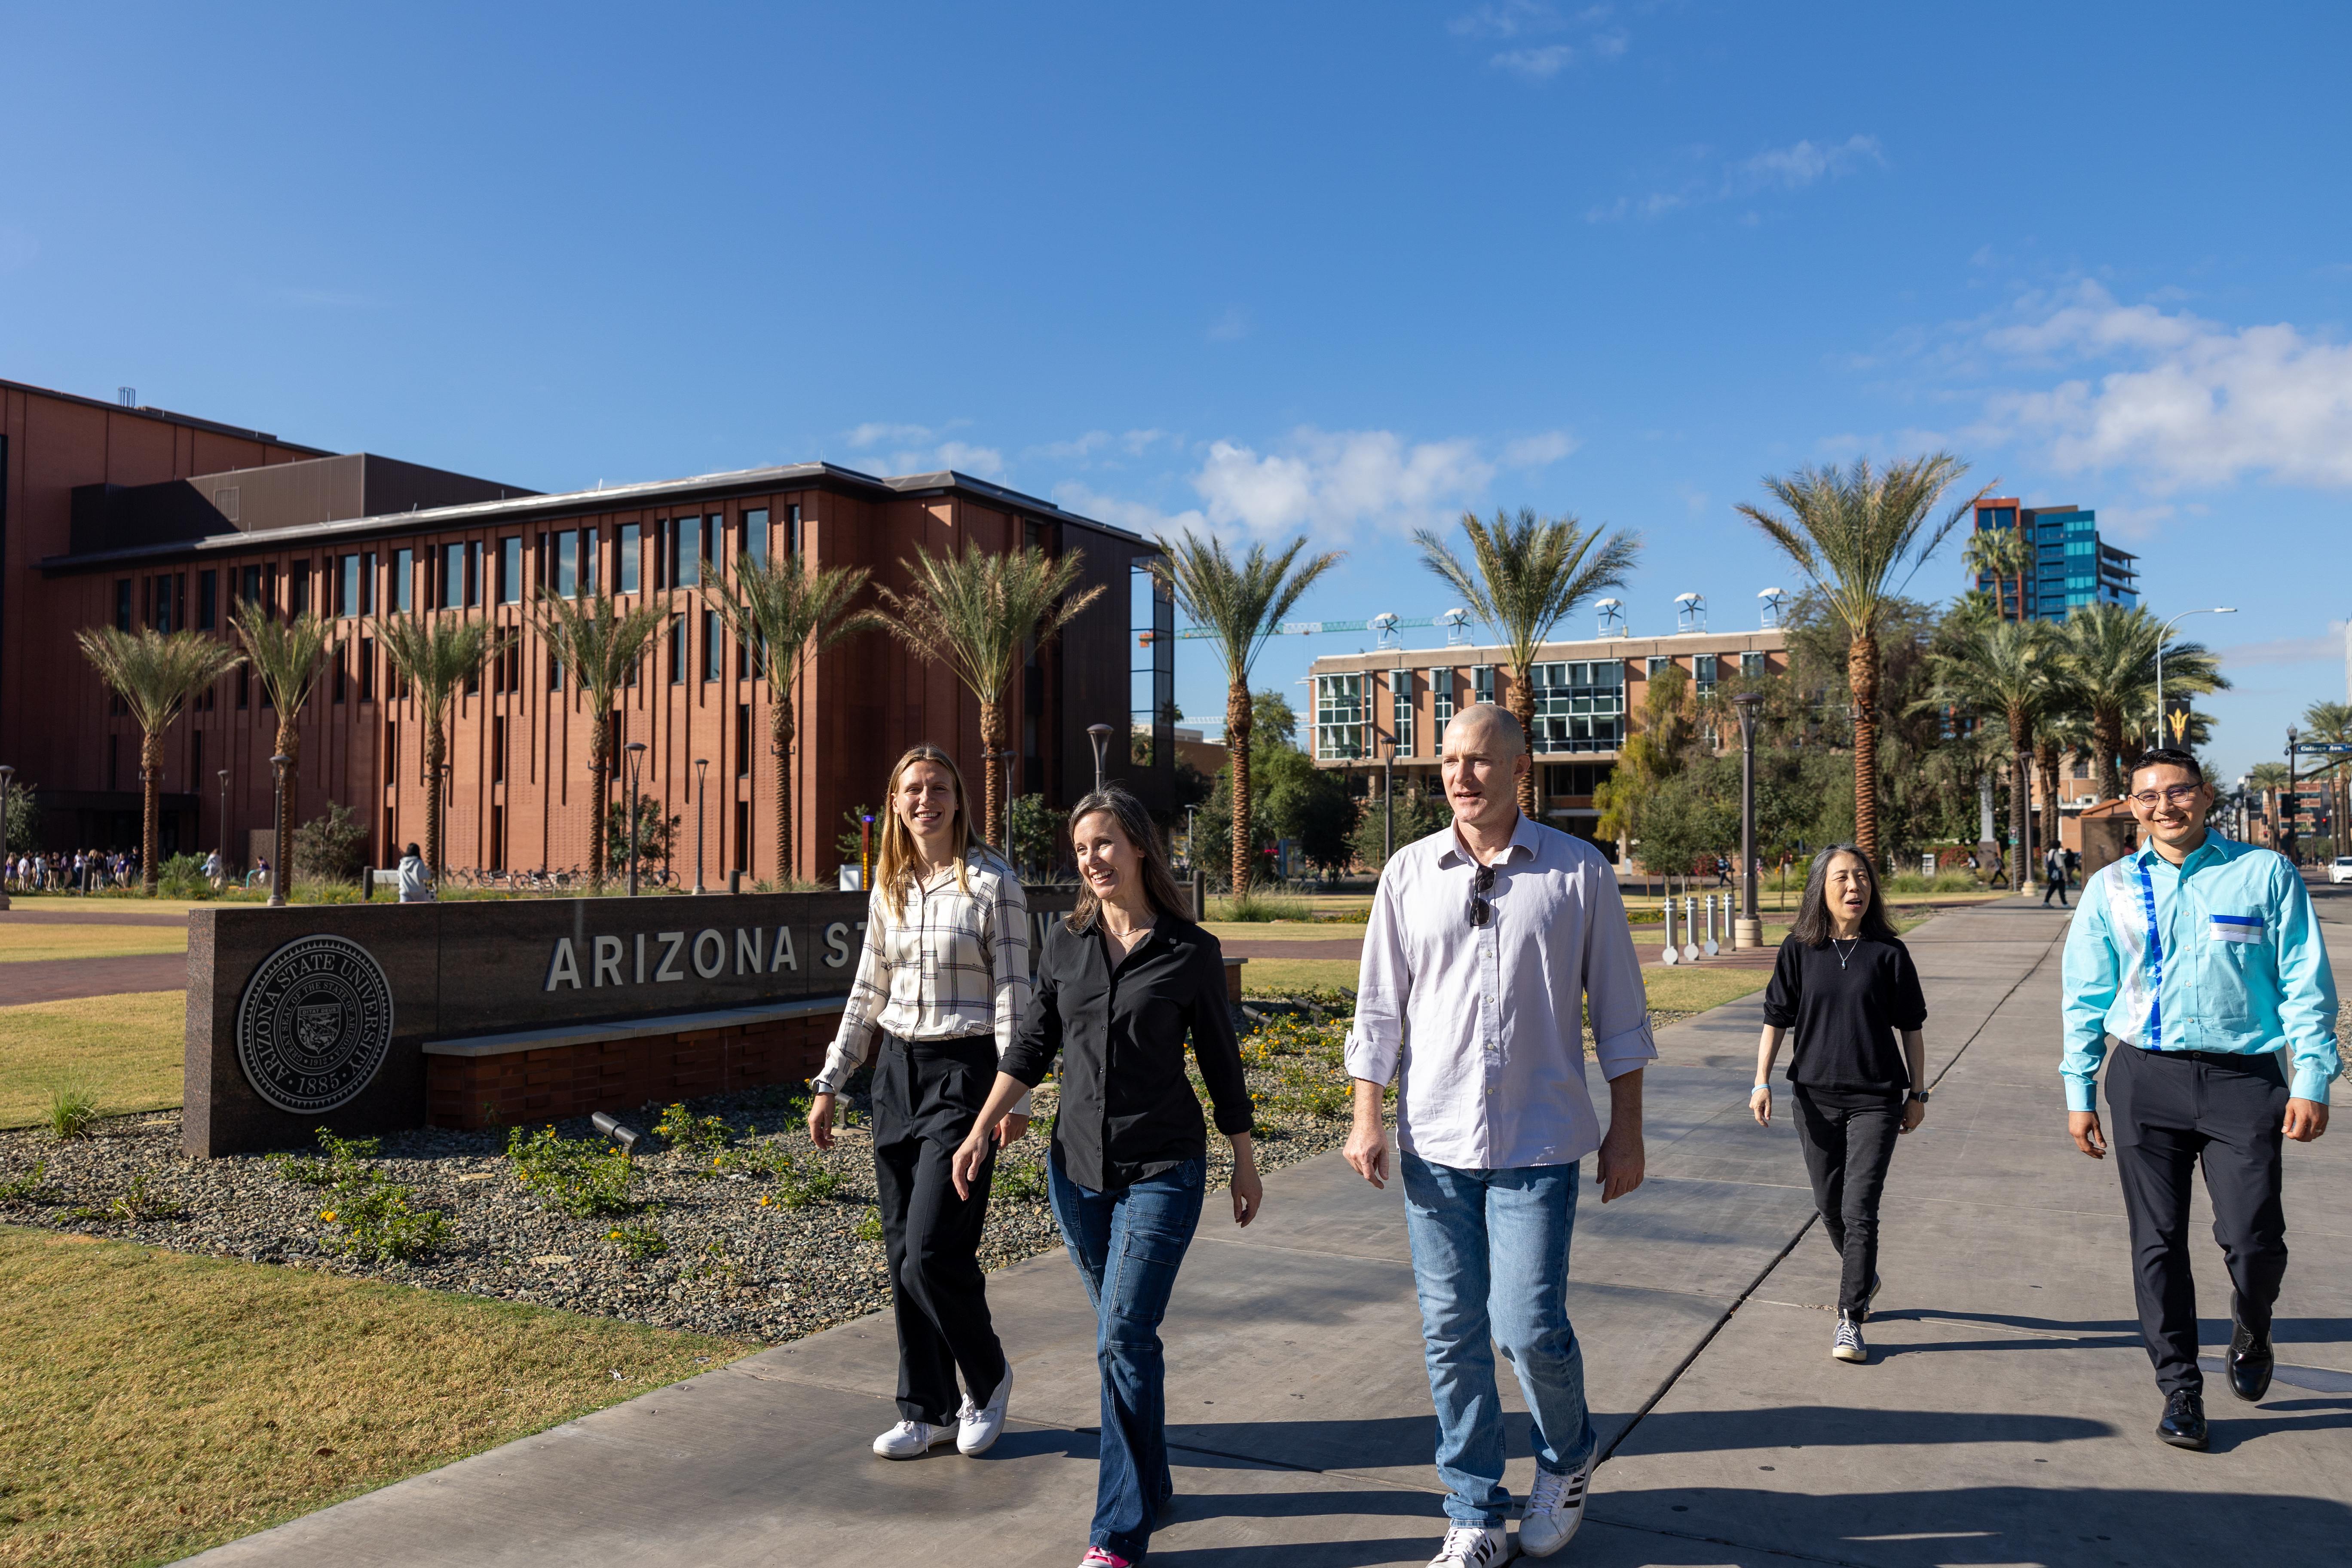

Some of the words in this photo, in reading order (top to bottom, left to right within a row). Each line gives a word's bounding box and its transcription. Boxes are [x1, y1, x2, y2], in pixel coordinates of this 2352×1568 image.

[545, 926, 797, 991] ARIZONA
[291, 991, 301, 1004] OF
[303, 982, 321, 994] THE
[323, 982, 348, 1001] STATE
[256, 992, 291, 1081] ARIZONA
[276, 954, 335, 989] STATE
[340, 958, 378, 1076] UNIVERSITY
[346, 1001, 354, 1012] OF
[282, 1006, 293, 1031] SEAL
[334, 1016, 355, 1057] ARIZONA
[282, 1035, 303, 1062] GREAT
[309, 1057, 327, 1066] 1912
[297, 1072, 339, 1094] 1885
